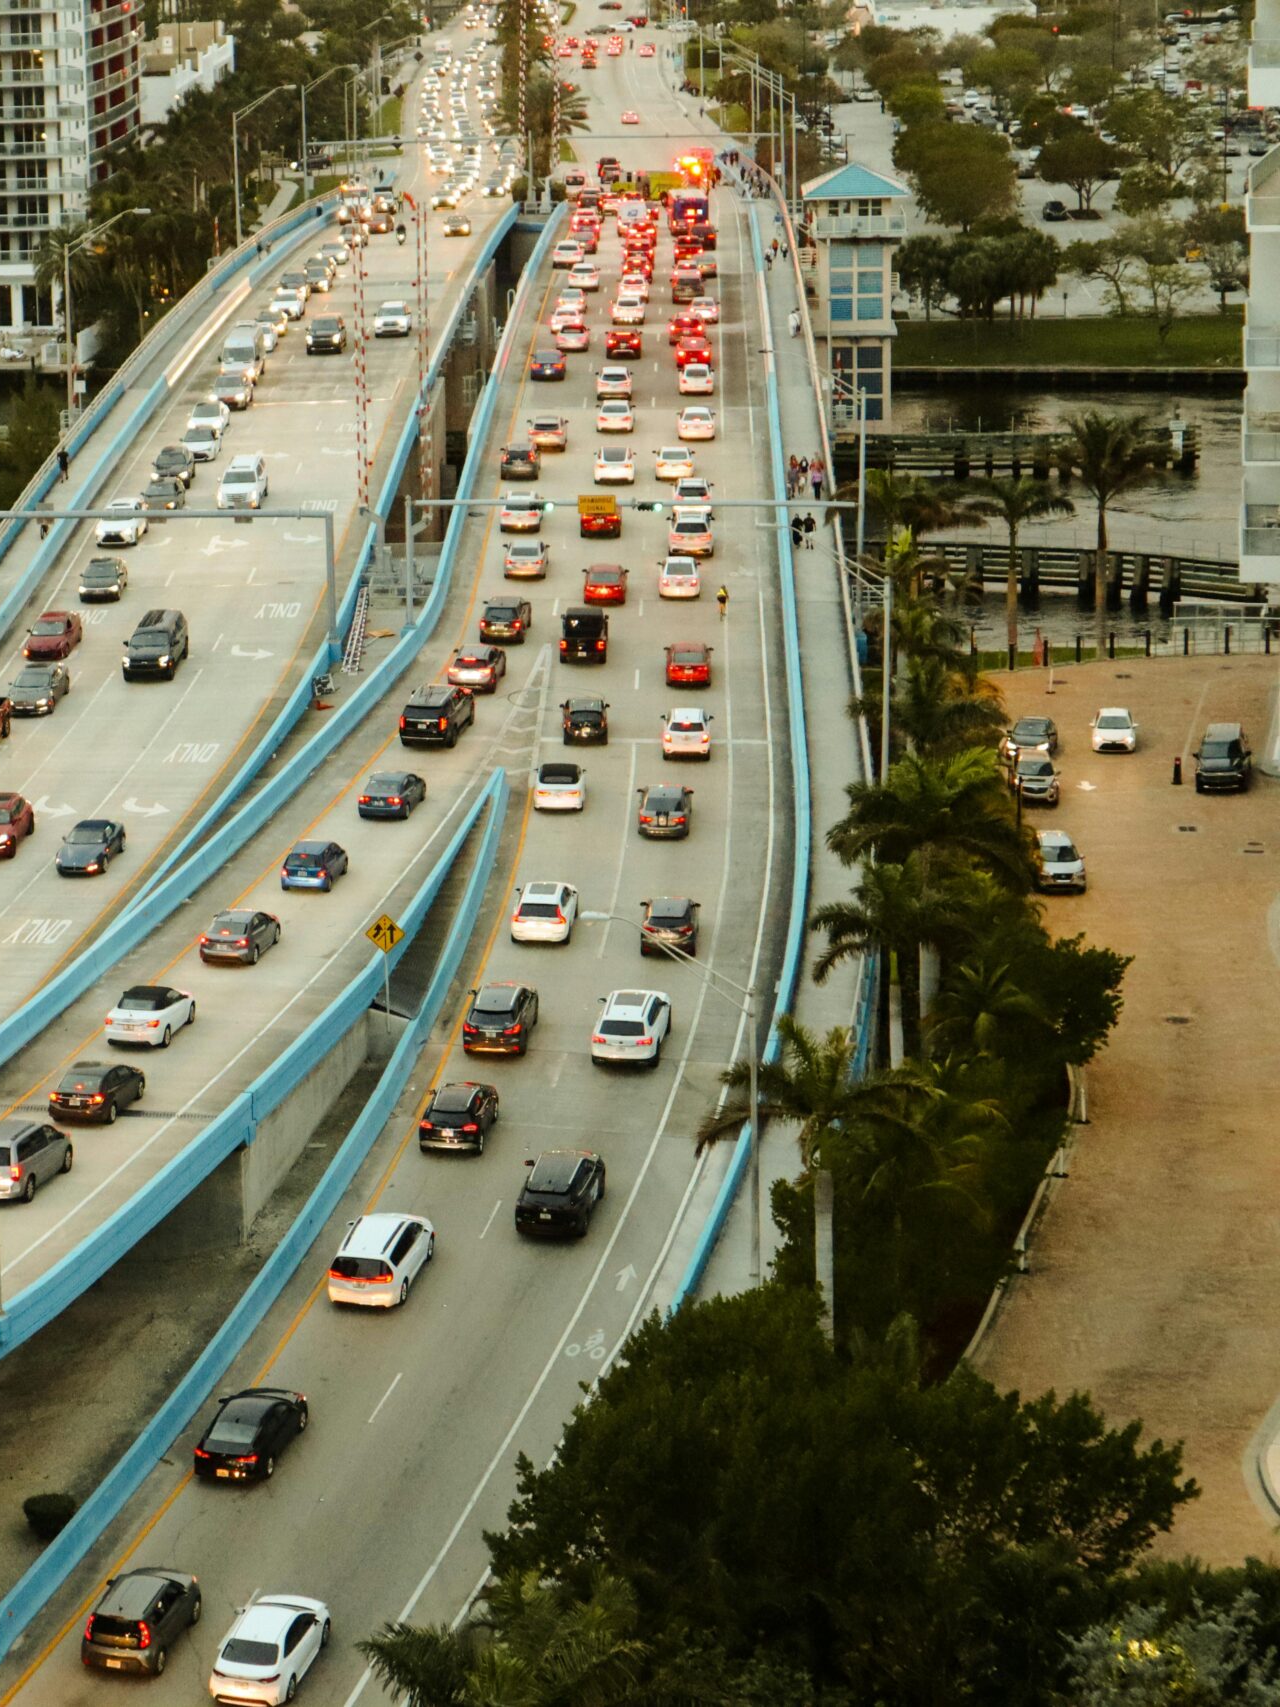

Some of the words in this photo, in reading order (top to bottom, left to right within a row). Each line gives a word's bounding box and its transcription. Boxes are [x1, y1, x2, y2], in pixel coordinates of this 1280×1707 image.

[254, 602, 302, 620] ONLY
[162, 743, 221, 763] ONLY
[1, 918, 73, 944] ONLY
